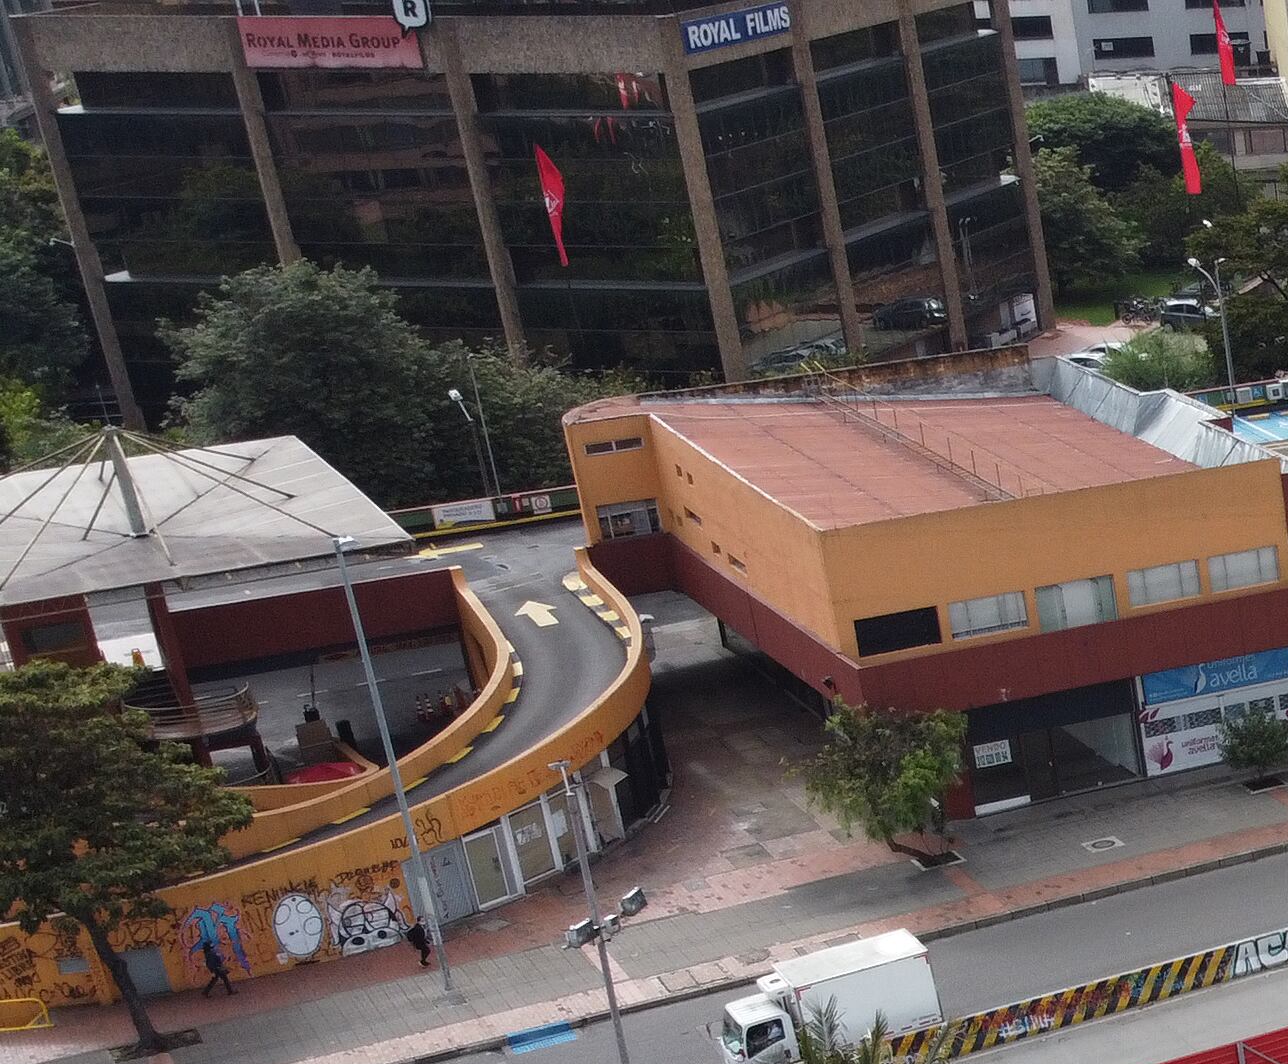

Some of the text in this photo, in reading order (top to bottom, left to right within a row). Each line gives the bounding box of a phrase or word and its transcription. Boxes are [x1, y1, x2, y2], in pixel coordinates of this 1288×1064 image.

[687, 6, 791, 49] ROYAL FILMS
[297, 33, 344, 49] MEDIA
[349, 33, 400, 49] GROUP
[1209, 663, 1258, 688] avella
